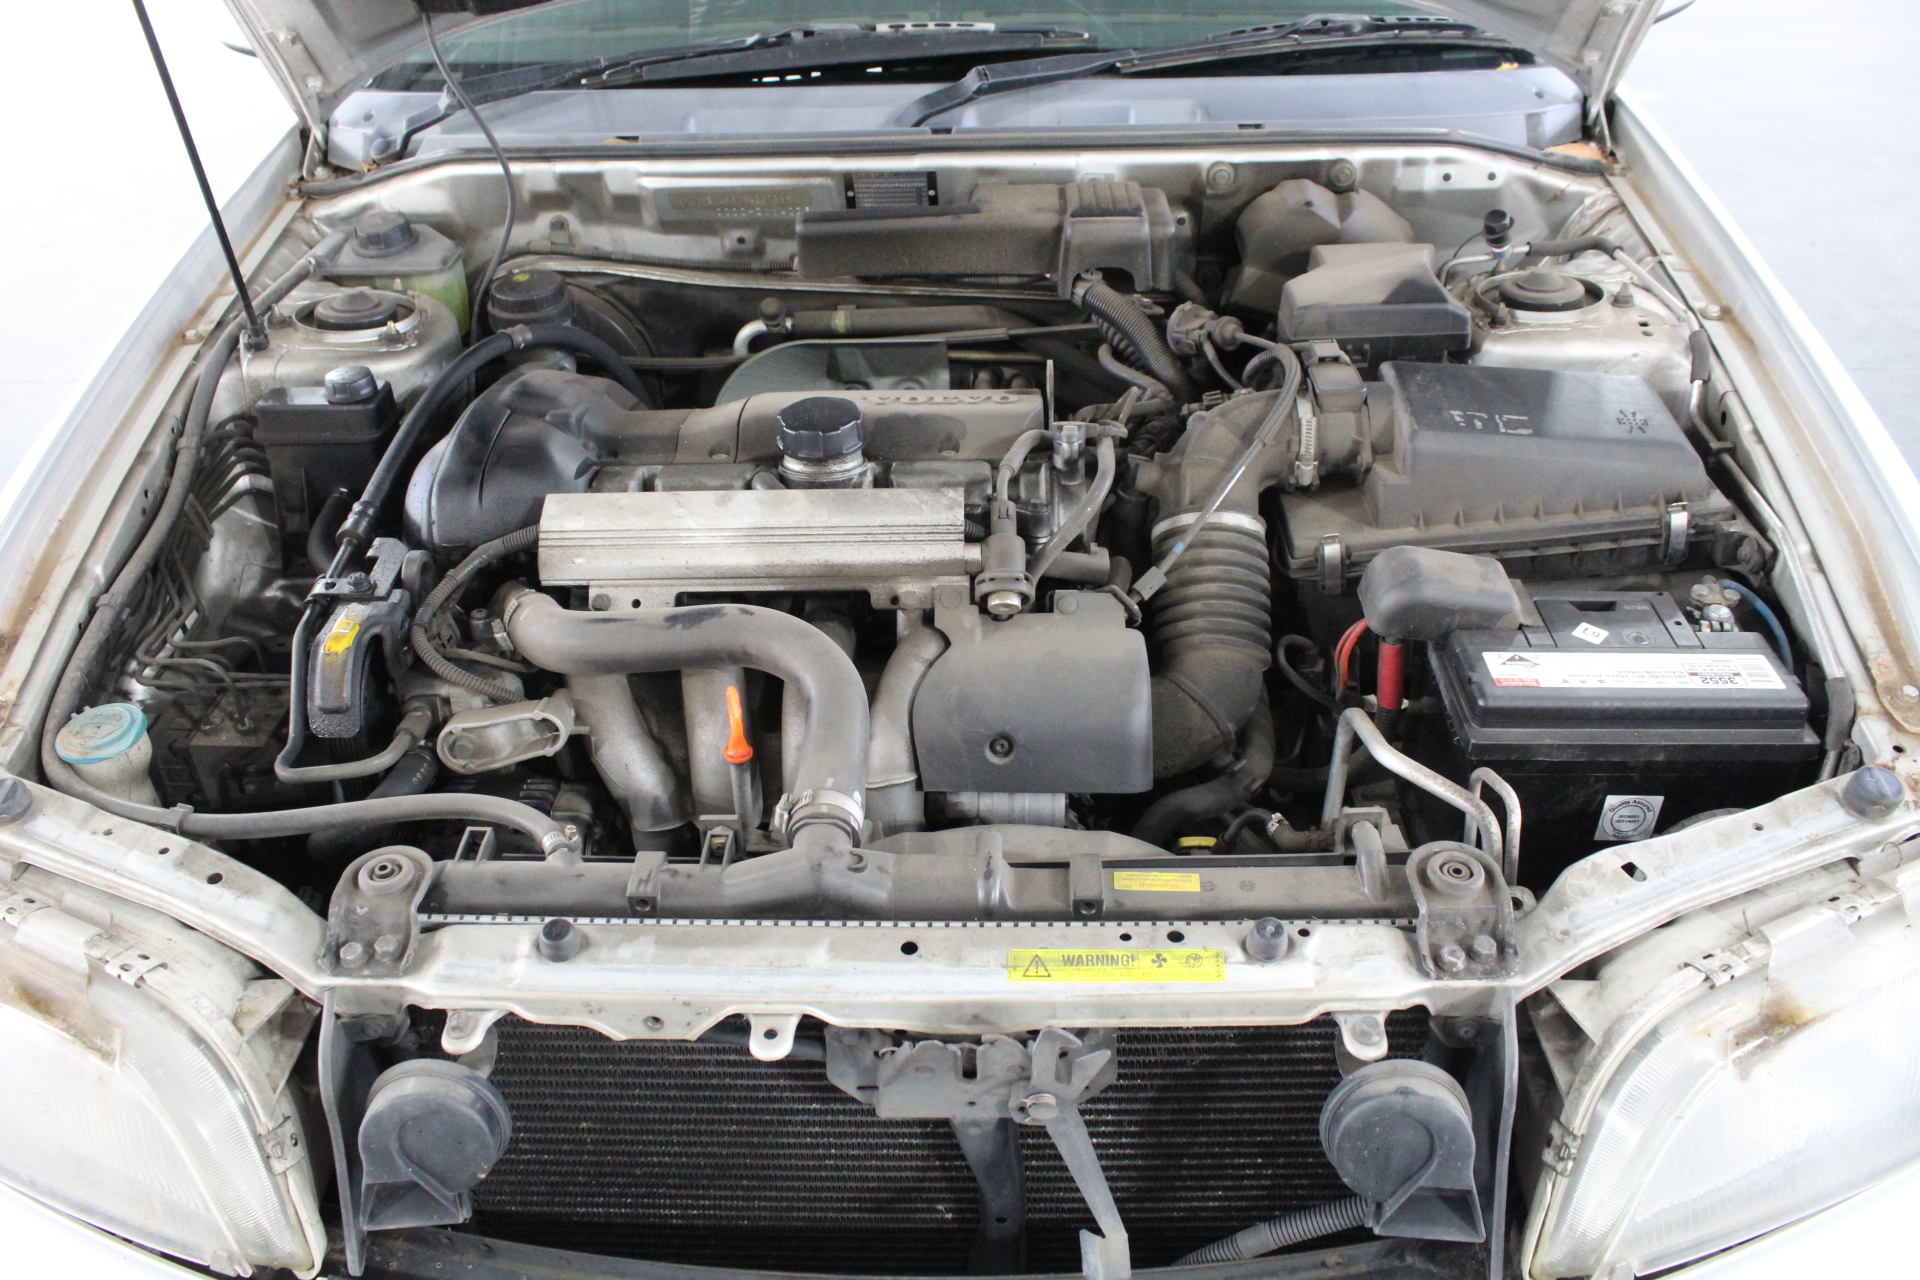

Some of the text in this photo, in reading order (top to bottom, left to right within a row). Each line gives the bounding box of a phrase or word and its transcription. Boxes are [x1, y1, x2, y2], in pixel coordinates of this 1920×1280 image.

[864, 395, 1020, 406] VOLVO
[1701, 677, 1739, 685] 3552
[1610, 799, 1653, 813] Quality Assured
[1139, 882, 1180, 890] Warning
[1061, 953, 1136, 967] WARNING!
